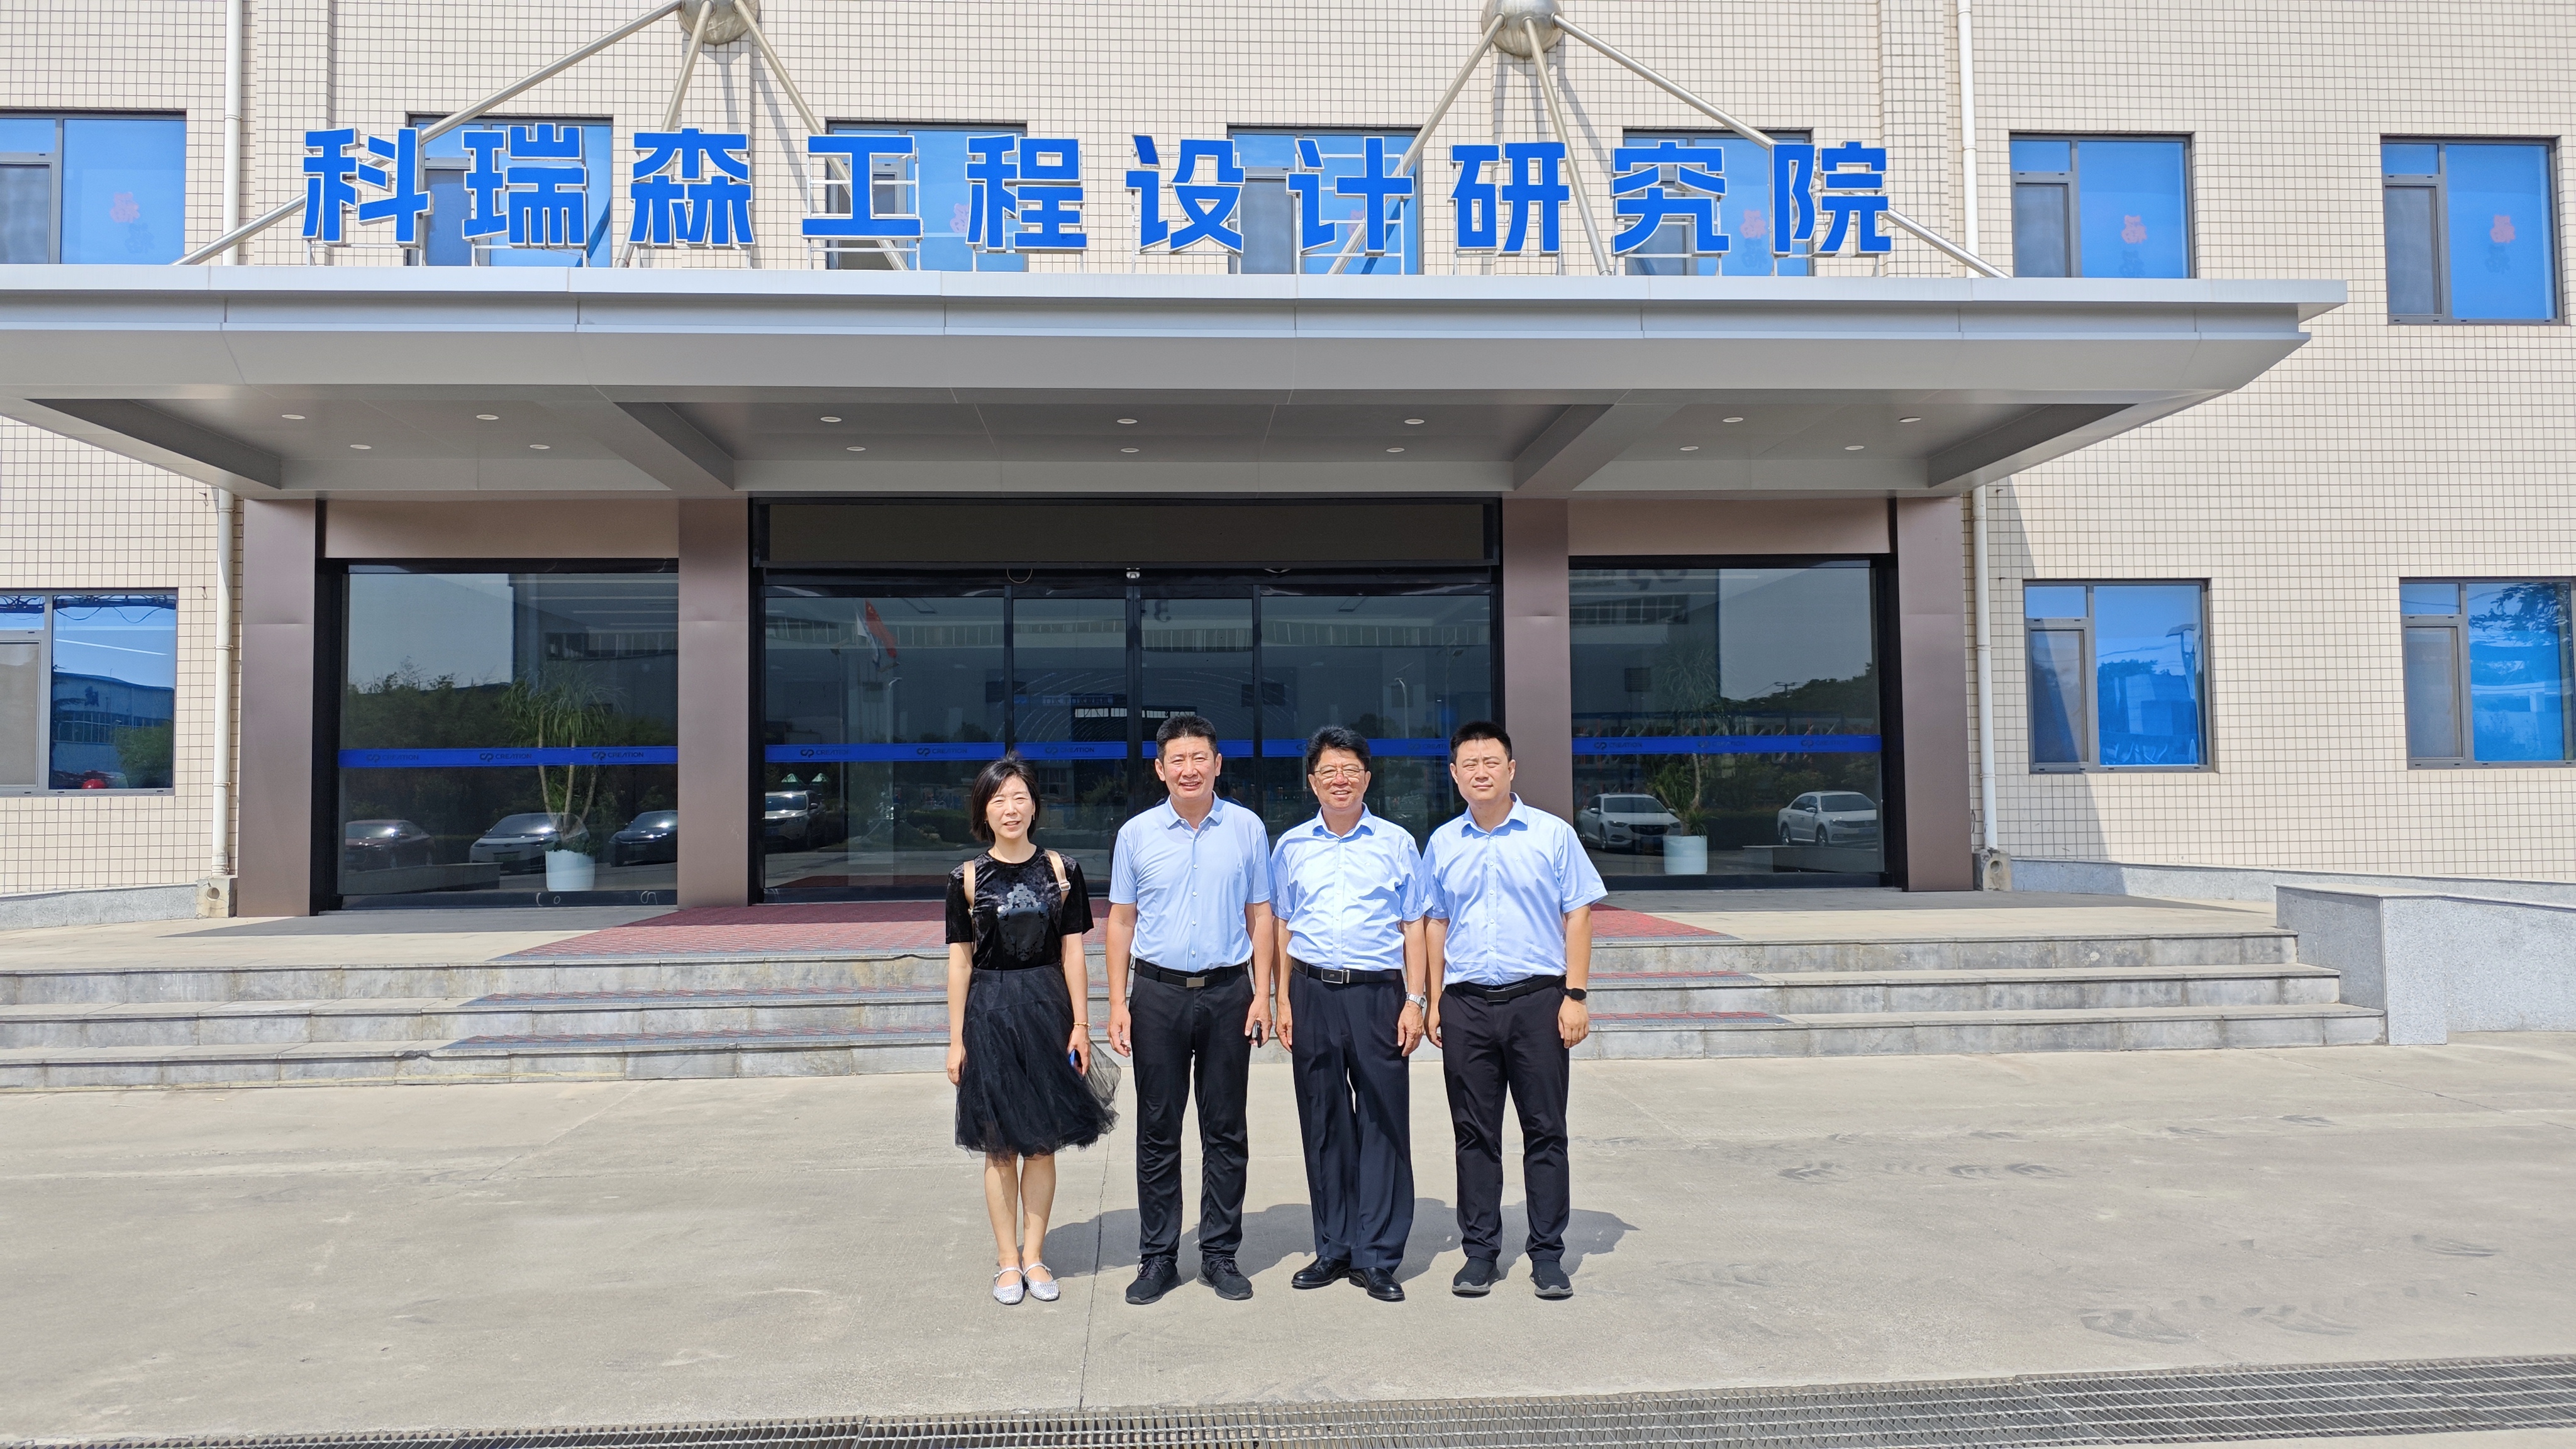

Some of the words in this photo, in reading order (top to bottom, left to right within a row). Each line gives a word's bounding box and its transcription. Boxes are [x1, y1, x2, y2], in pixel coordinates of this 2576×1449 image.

[302, 122, 1892, 256] 科瑞森工程设计研究院
